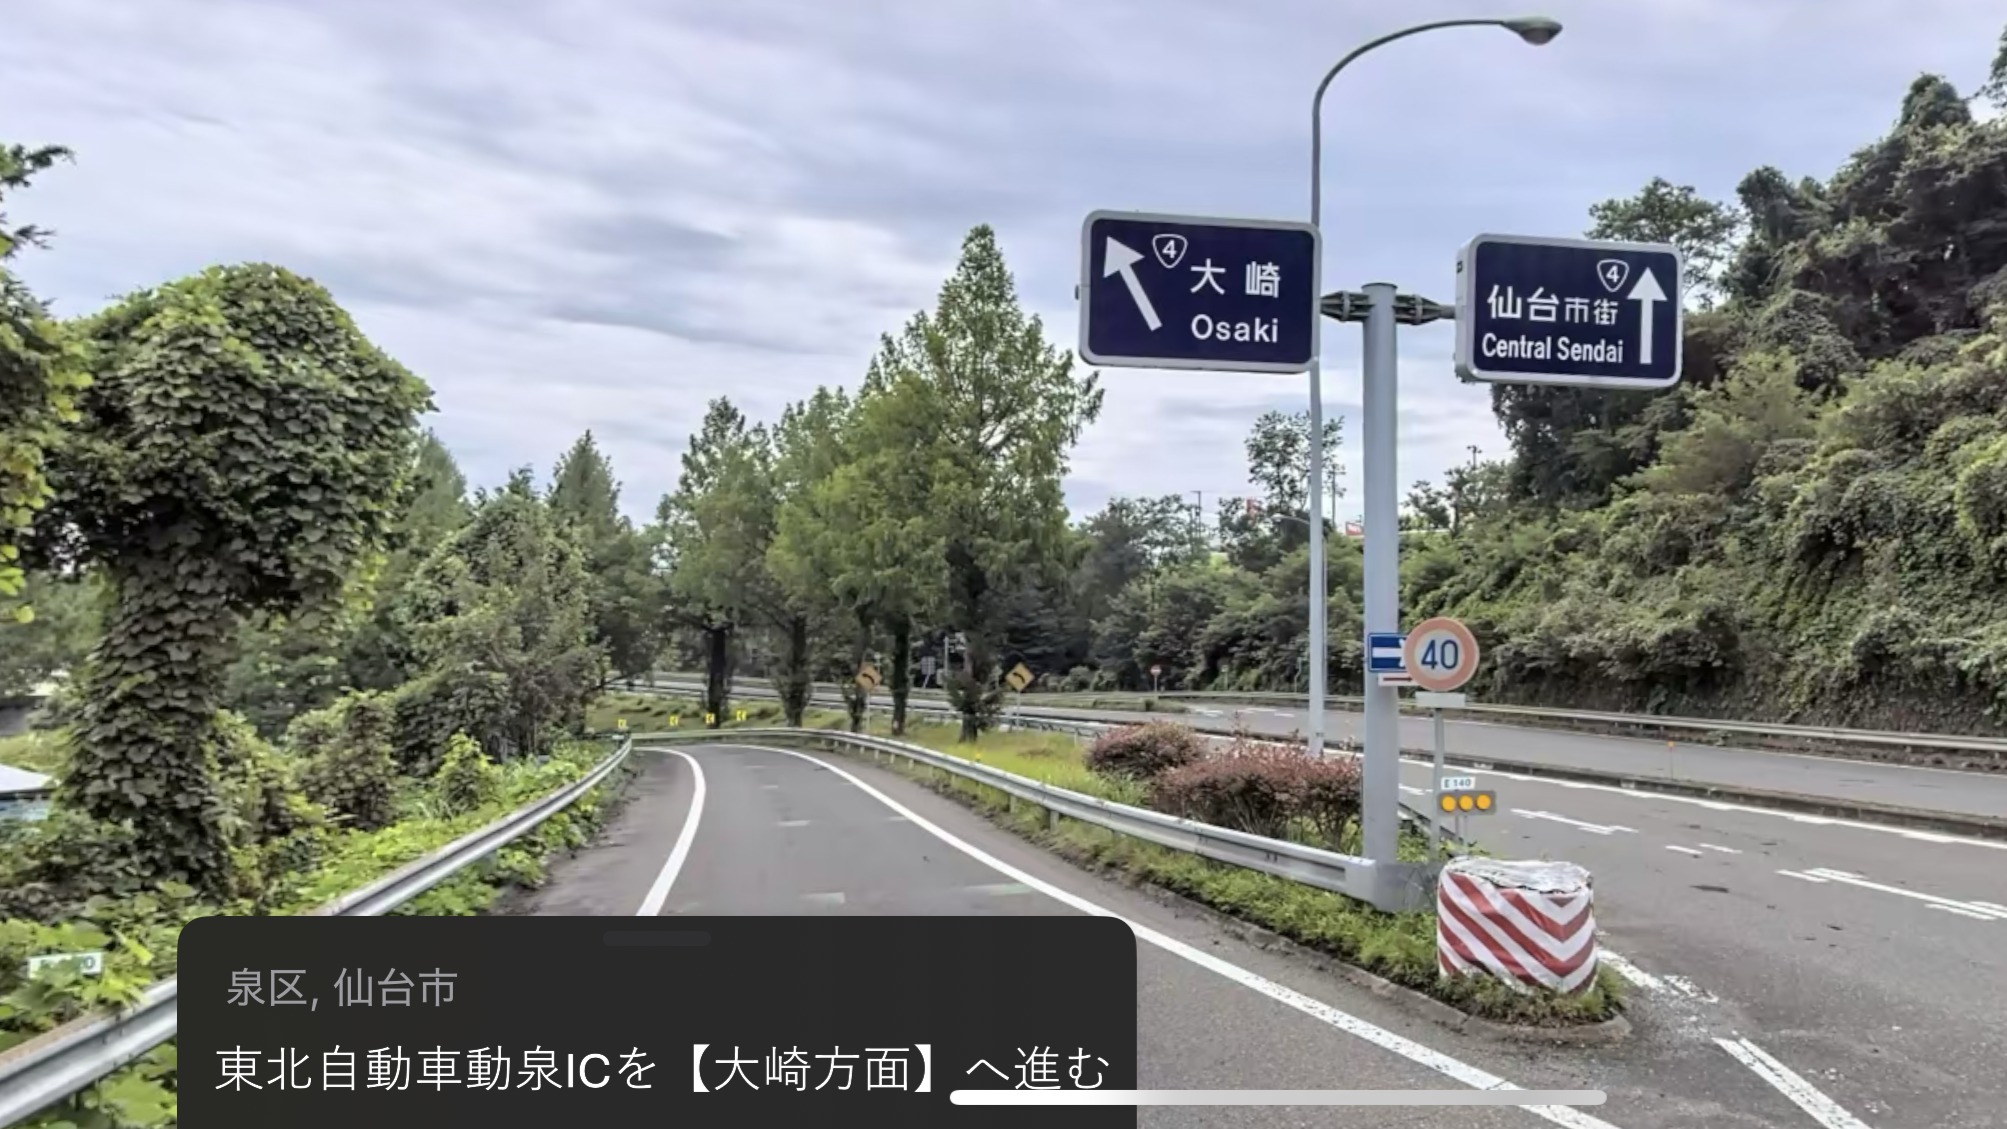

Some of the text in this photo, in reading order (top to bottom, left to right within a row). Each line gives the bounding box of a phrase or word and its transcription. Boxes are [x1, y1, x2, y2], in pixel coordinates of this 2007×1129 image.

[1161, 239, 1178, 259] 4
[1190, 258, 1281, 298] 大崎
[1605, 264, 1621, 283] 4
[1487, 284, 1619, 326] 仙台市街
[1191, 313, 1279, 343] Osaki
[1482, 332, 1624, 364] Central Sendai
[1421, 639, 1459, 670] 40
